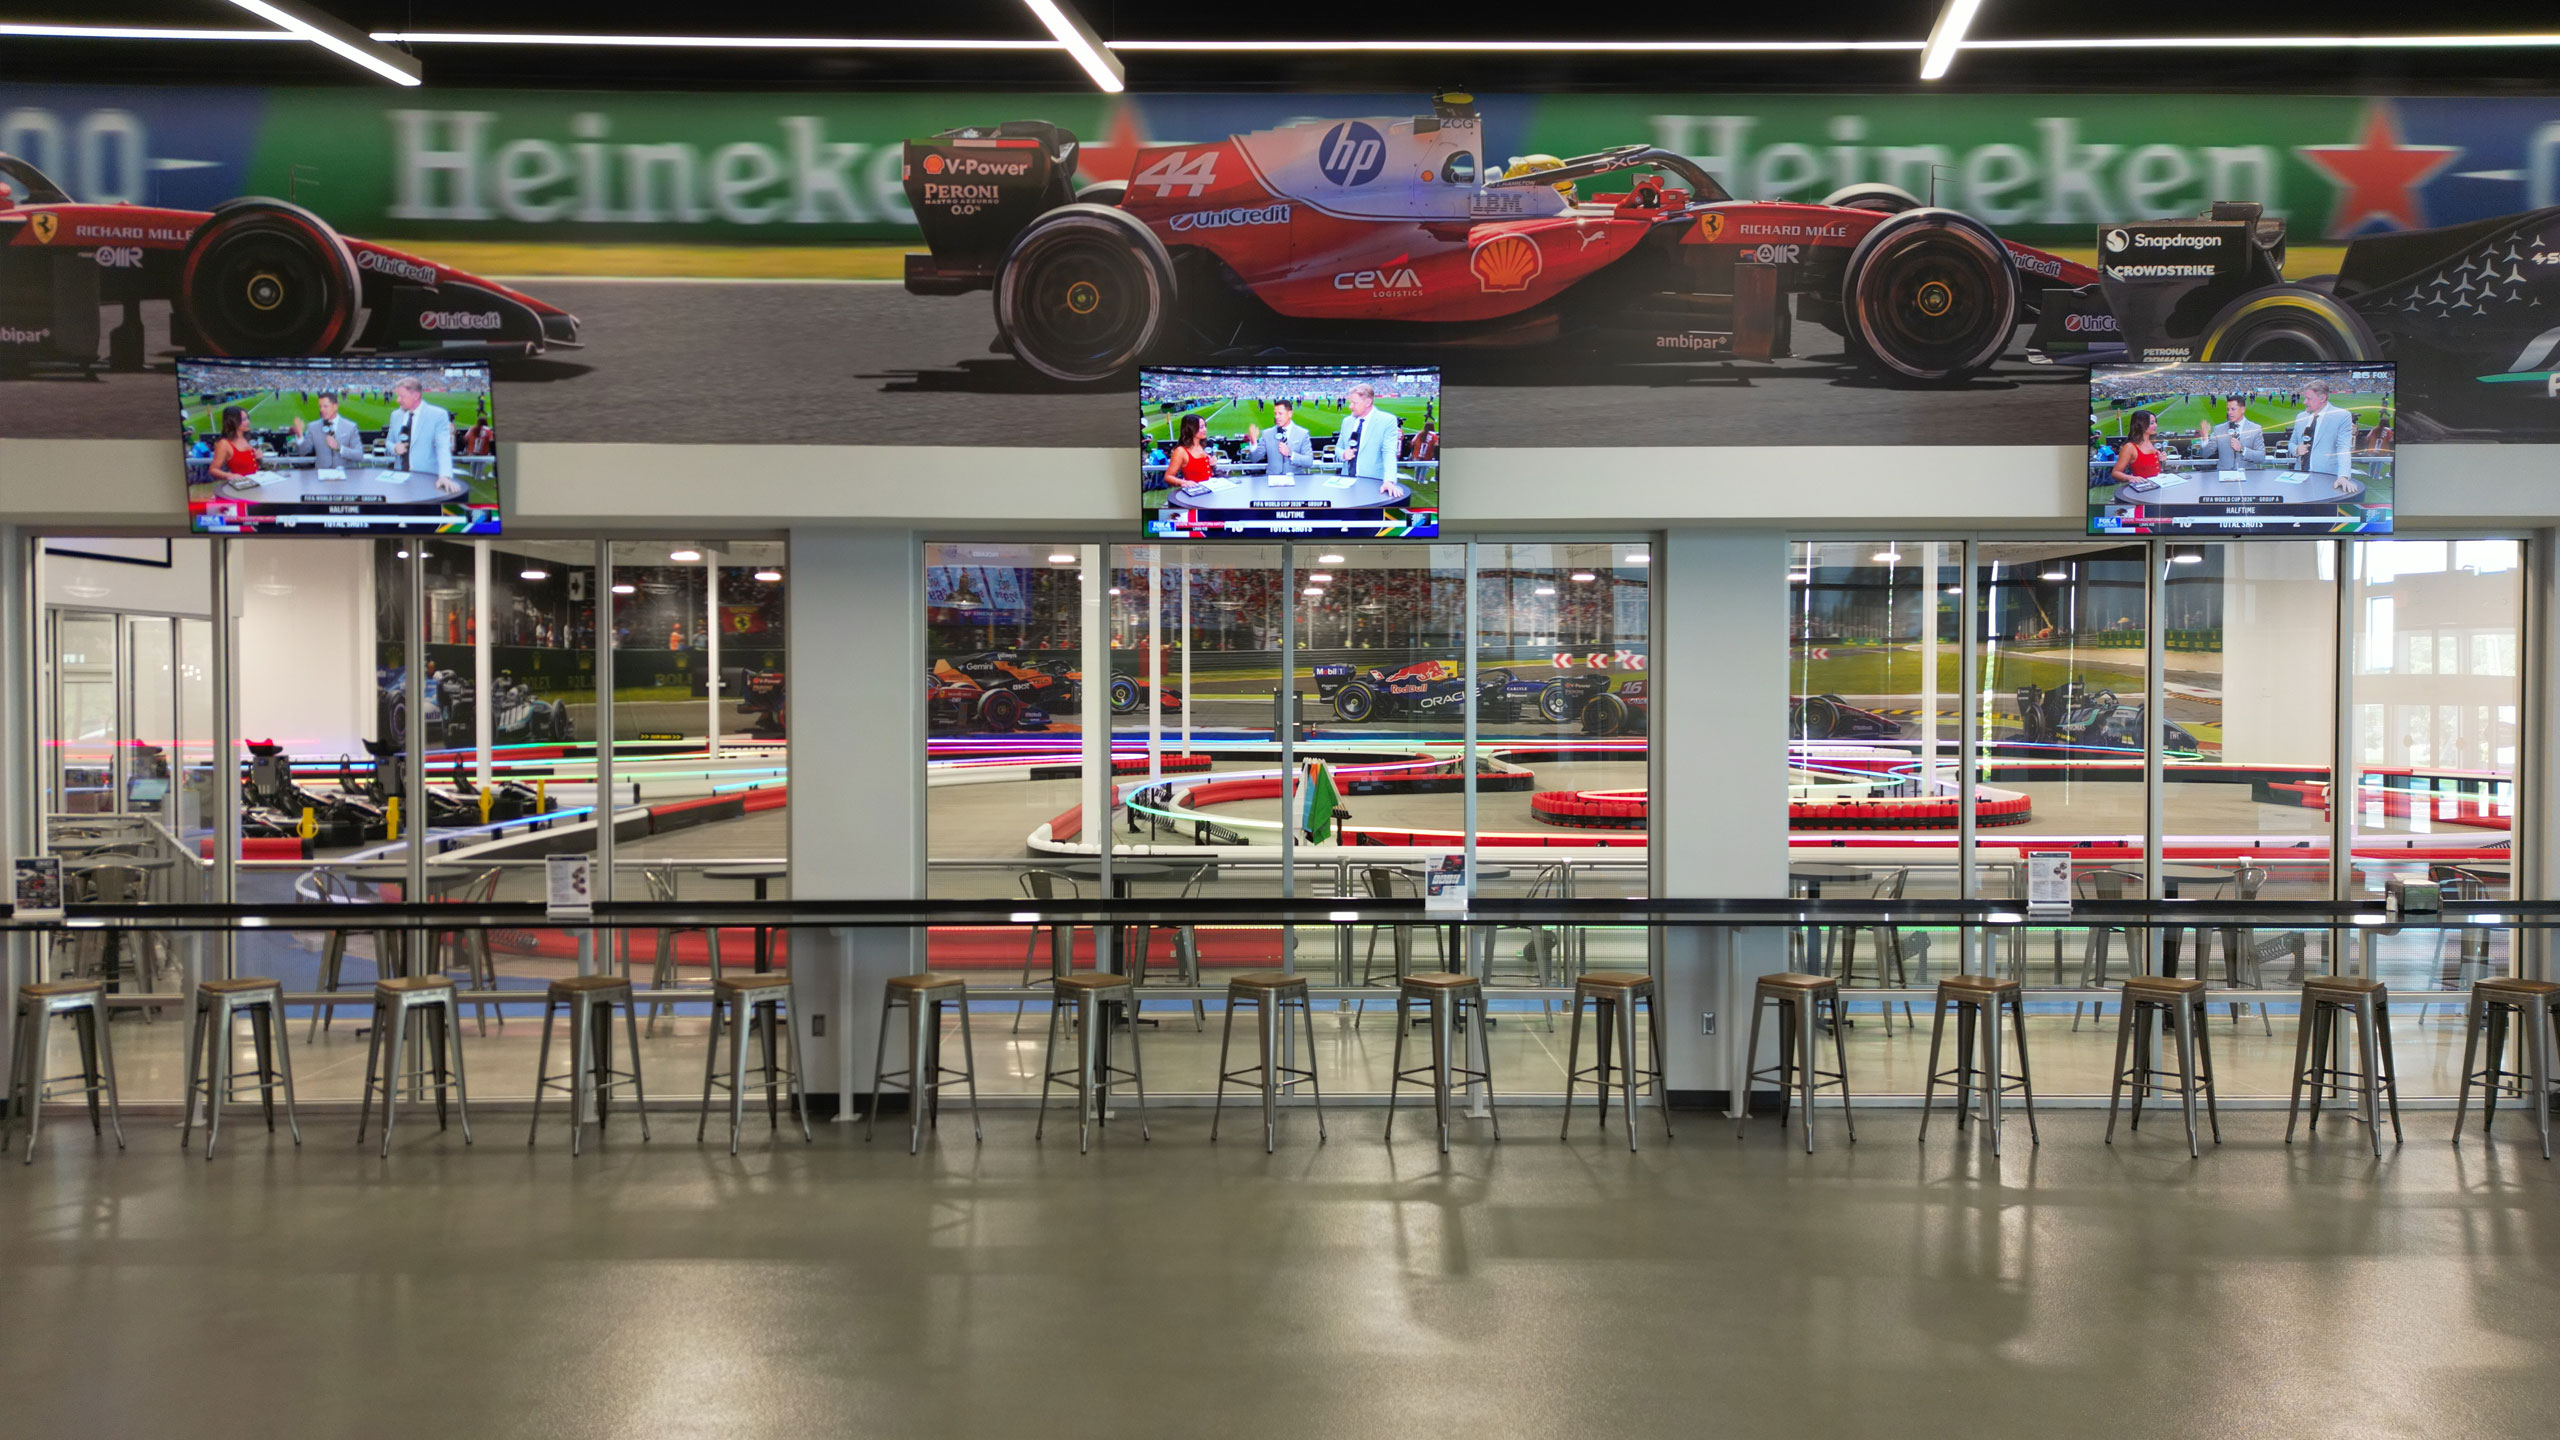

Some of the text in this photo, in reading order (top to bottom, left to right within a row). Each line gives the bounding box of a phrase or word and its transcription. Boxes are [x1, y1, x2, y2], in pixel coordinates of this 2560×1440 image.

[1441, 119, 1474, 129] ZCG
[1325, 121, 1381, 187] hp
[945, 159, 1028, 175] V-Power
[1134, 152, 1220, 197] 44
[1650, 114, 2287, 225] Heineken
[924, 183, 999, 199] PERONI
[1473, 193, 1522, 213] IBM
[1196, 205, 1290, 228] UniCredit
[76, 225, 143, 239] RICHARD
[1740, 224, 1847, 237] RICHARD MILLE
[2134, 233, 2222, 250] Snapdragon
[374, 255, 436, 285] UniCredit
[2114, 265, 2216, 276] CROWDSTRIKE
[1373, 290, 1424, 298] LOGISTICS
[438, 311, 501, 329] UniCredit
[2143, 347, 2191, 356] PETRONAS
[328, 505, 359, 513] HALFTIME
[1316, 667, 1337, 676] Mobil
[1390, 684, 1428, 694] Red Bull
[1622, 681, 1643, 694] 16
